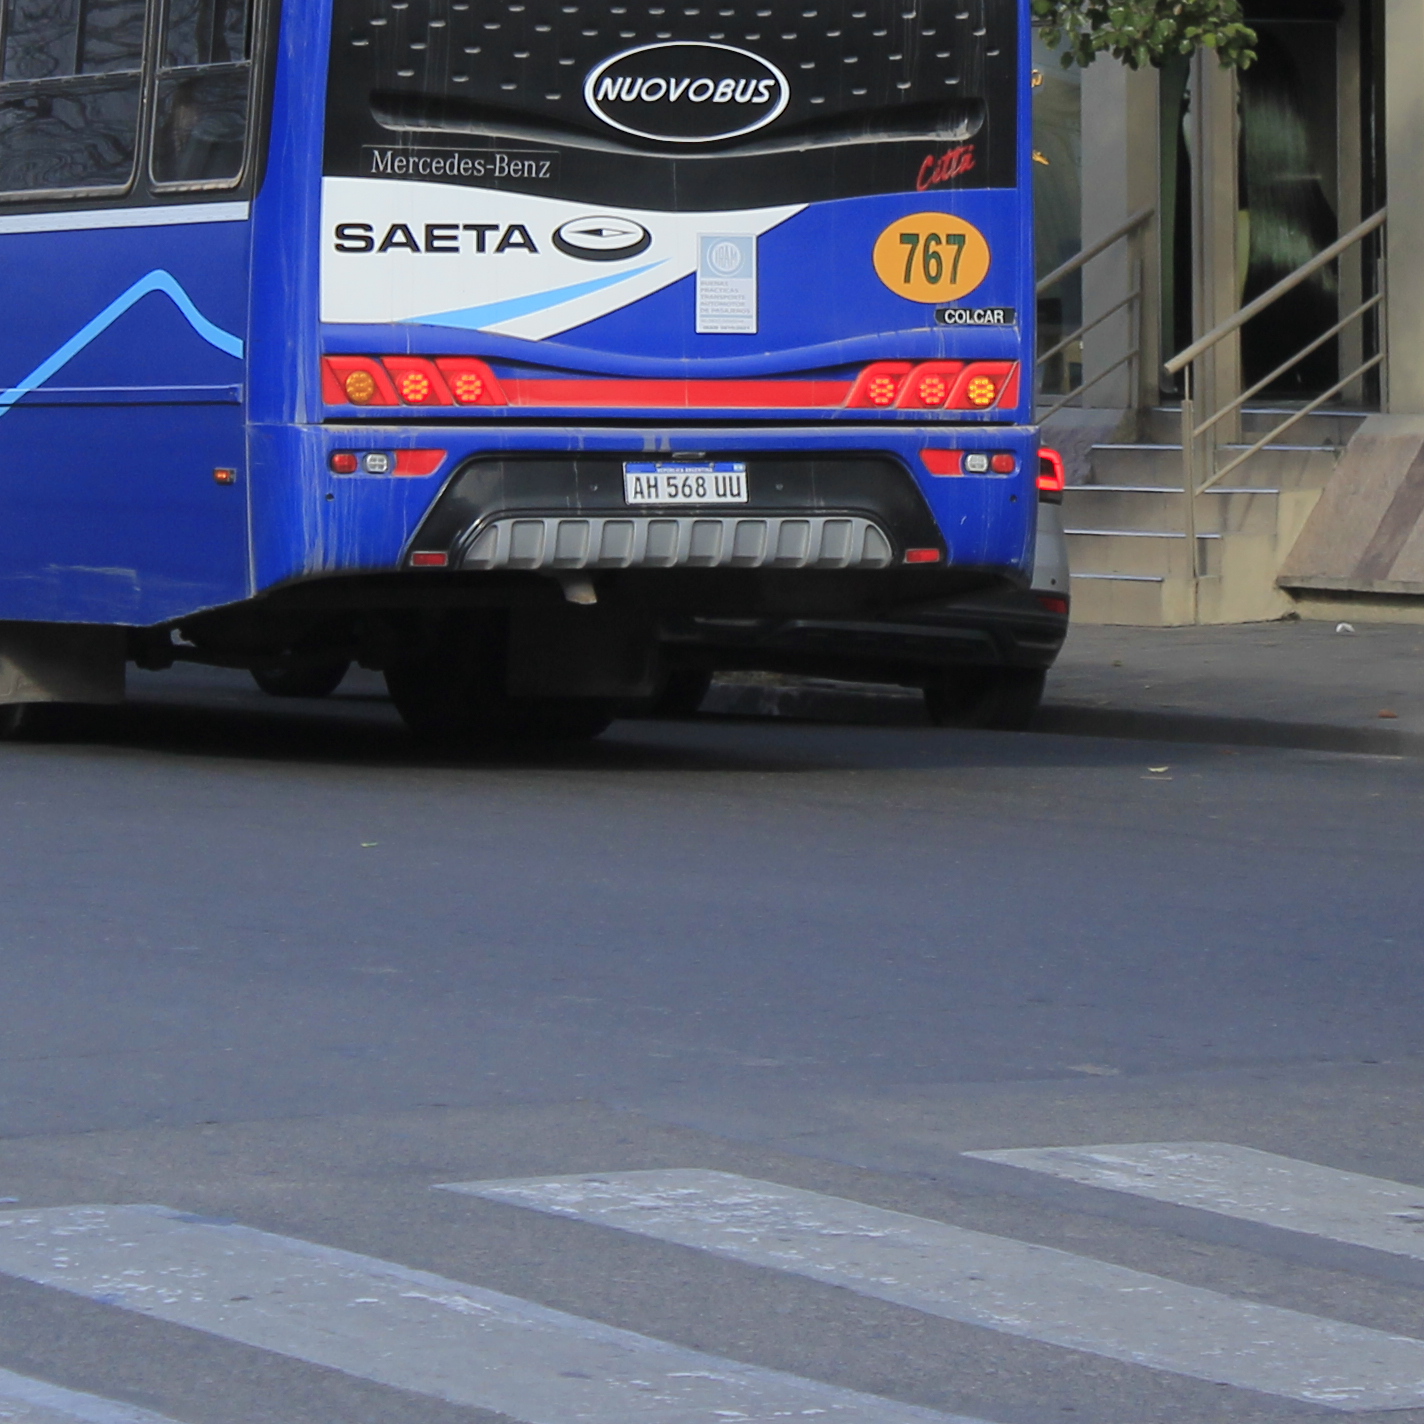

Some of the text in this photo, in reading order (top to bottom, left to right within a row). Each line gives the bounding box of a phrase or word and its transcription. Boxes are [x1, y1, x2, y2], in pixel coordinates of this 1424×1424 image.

[596, 77, 776, 104] NUOVOBUS
[370, 149, 552, 179] Mercedes-Benz
[333, 222, 541, 255] SAETA
[899, 232, 967, 285] 767
[943, 309, 1005, 325] COLCAR
[633, 475, 743, 500] AH 568 UU
